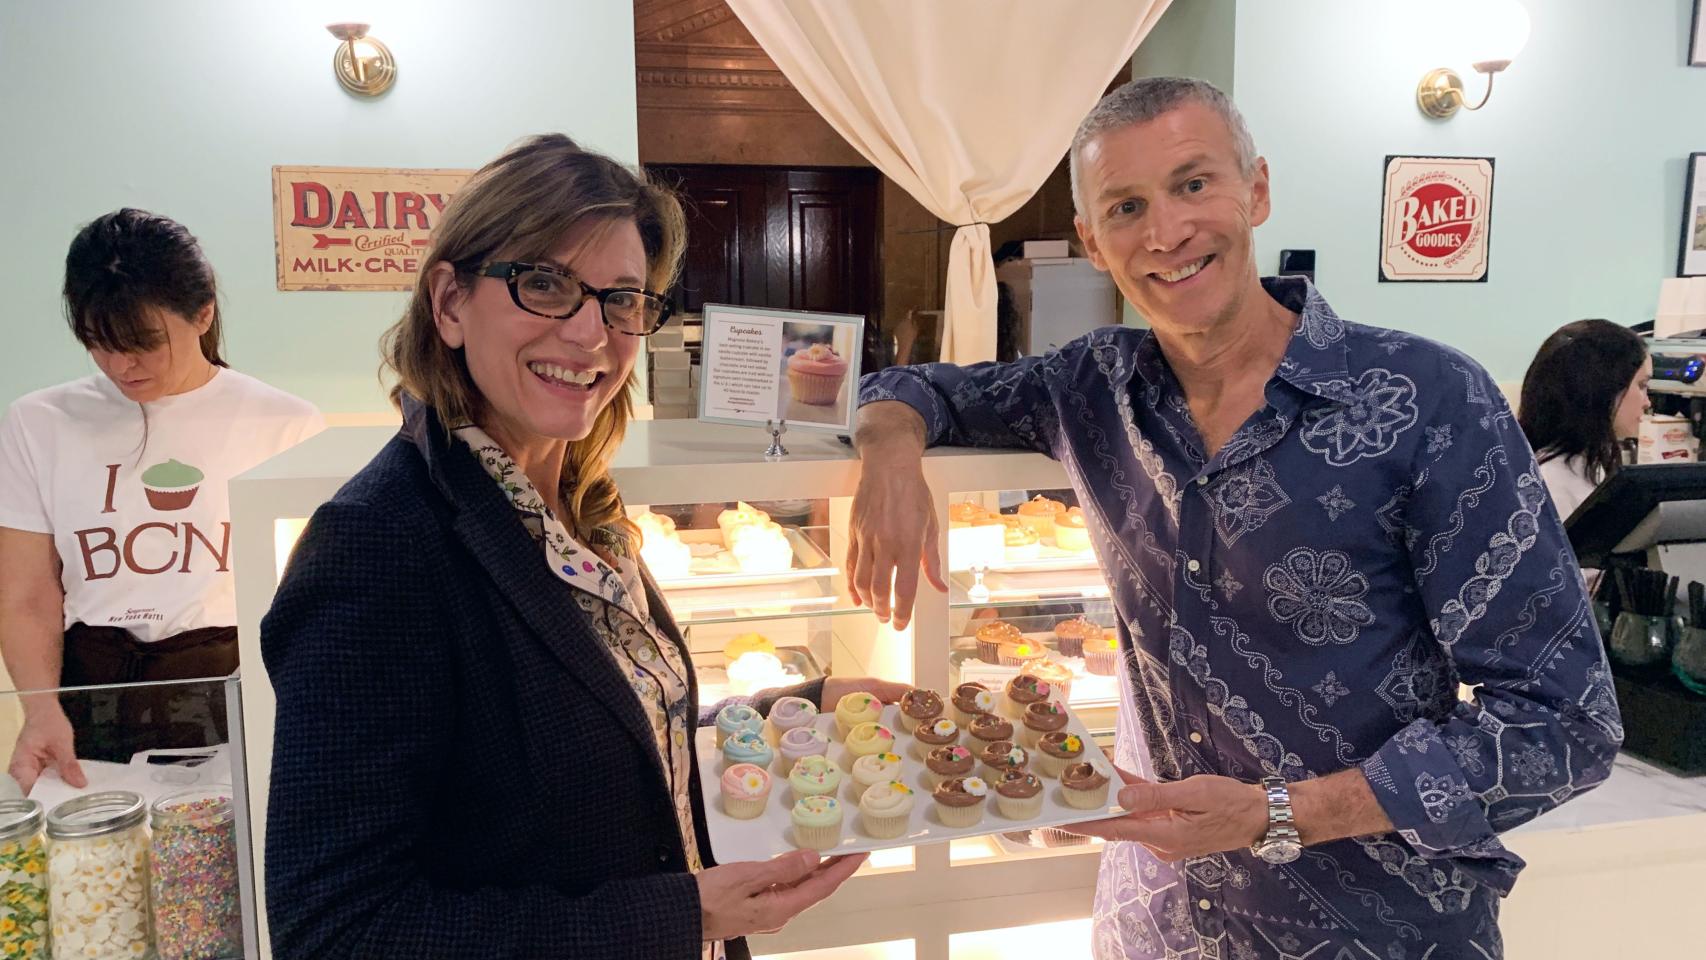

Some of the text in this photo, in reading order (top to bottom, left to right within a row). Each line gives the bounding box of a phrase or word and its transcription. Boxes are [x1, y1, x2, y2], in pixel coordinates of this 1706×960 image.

[1390, 194, 1482, 248] BAKED
[355, 232, 410, 251] Certified
[1416, 233, 1462, 247] GOODIES
[364, 257, 418, 273] CRE
[730, 325, 762, 336] Cupcakes
[101, 464, 122, 513] I
[74, 522, 231, 581] BCN
